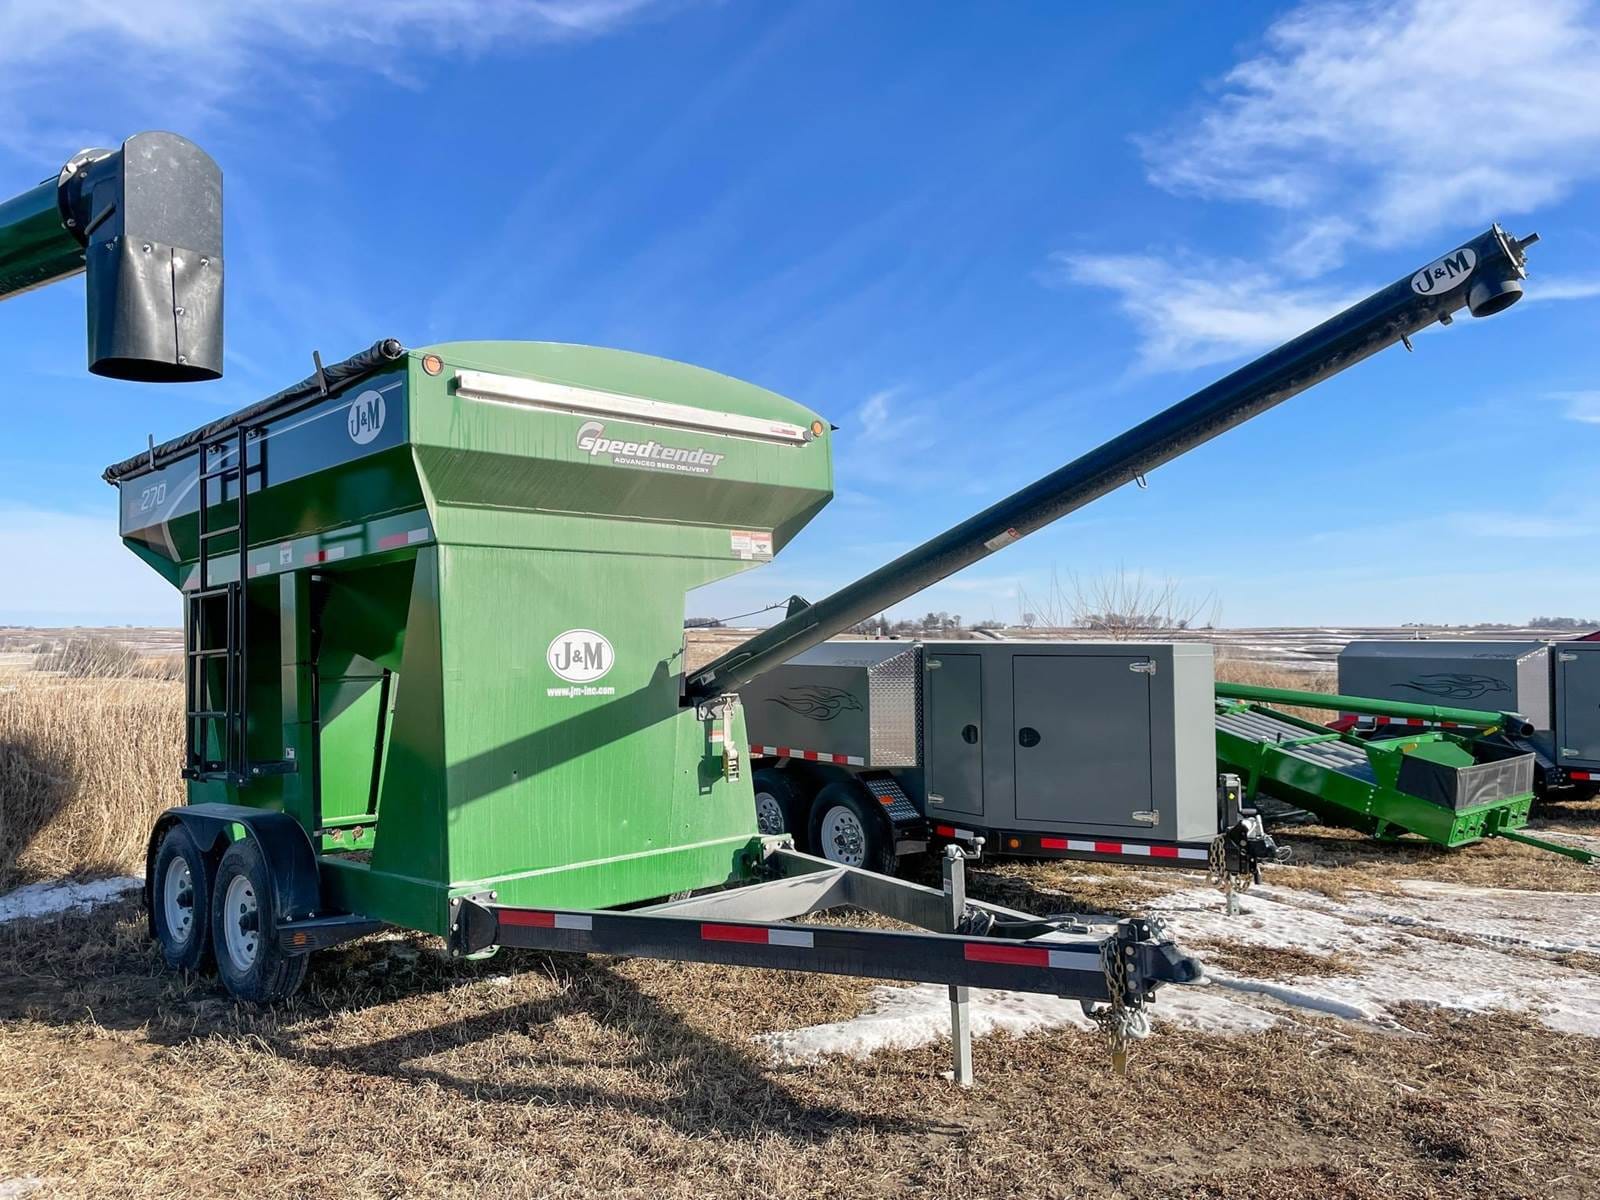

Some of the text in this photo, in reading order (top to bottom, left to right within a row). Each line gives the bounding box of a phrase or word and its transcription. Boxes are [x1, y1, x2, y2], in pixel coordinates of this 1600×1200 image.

[1415, 251, 1472, 293] J&M
[351, 398, 380, 437] J&M
[614, 457, 709, 473] ADVANCED SEED DELIVERY
[141, 483, 166, 511] 270
[554, 642, 603, 670] J&M
[547, 686, 615, 698] www.jm-inc.com
